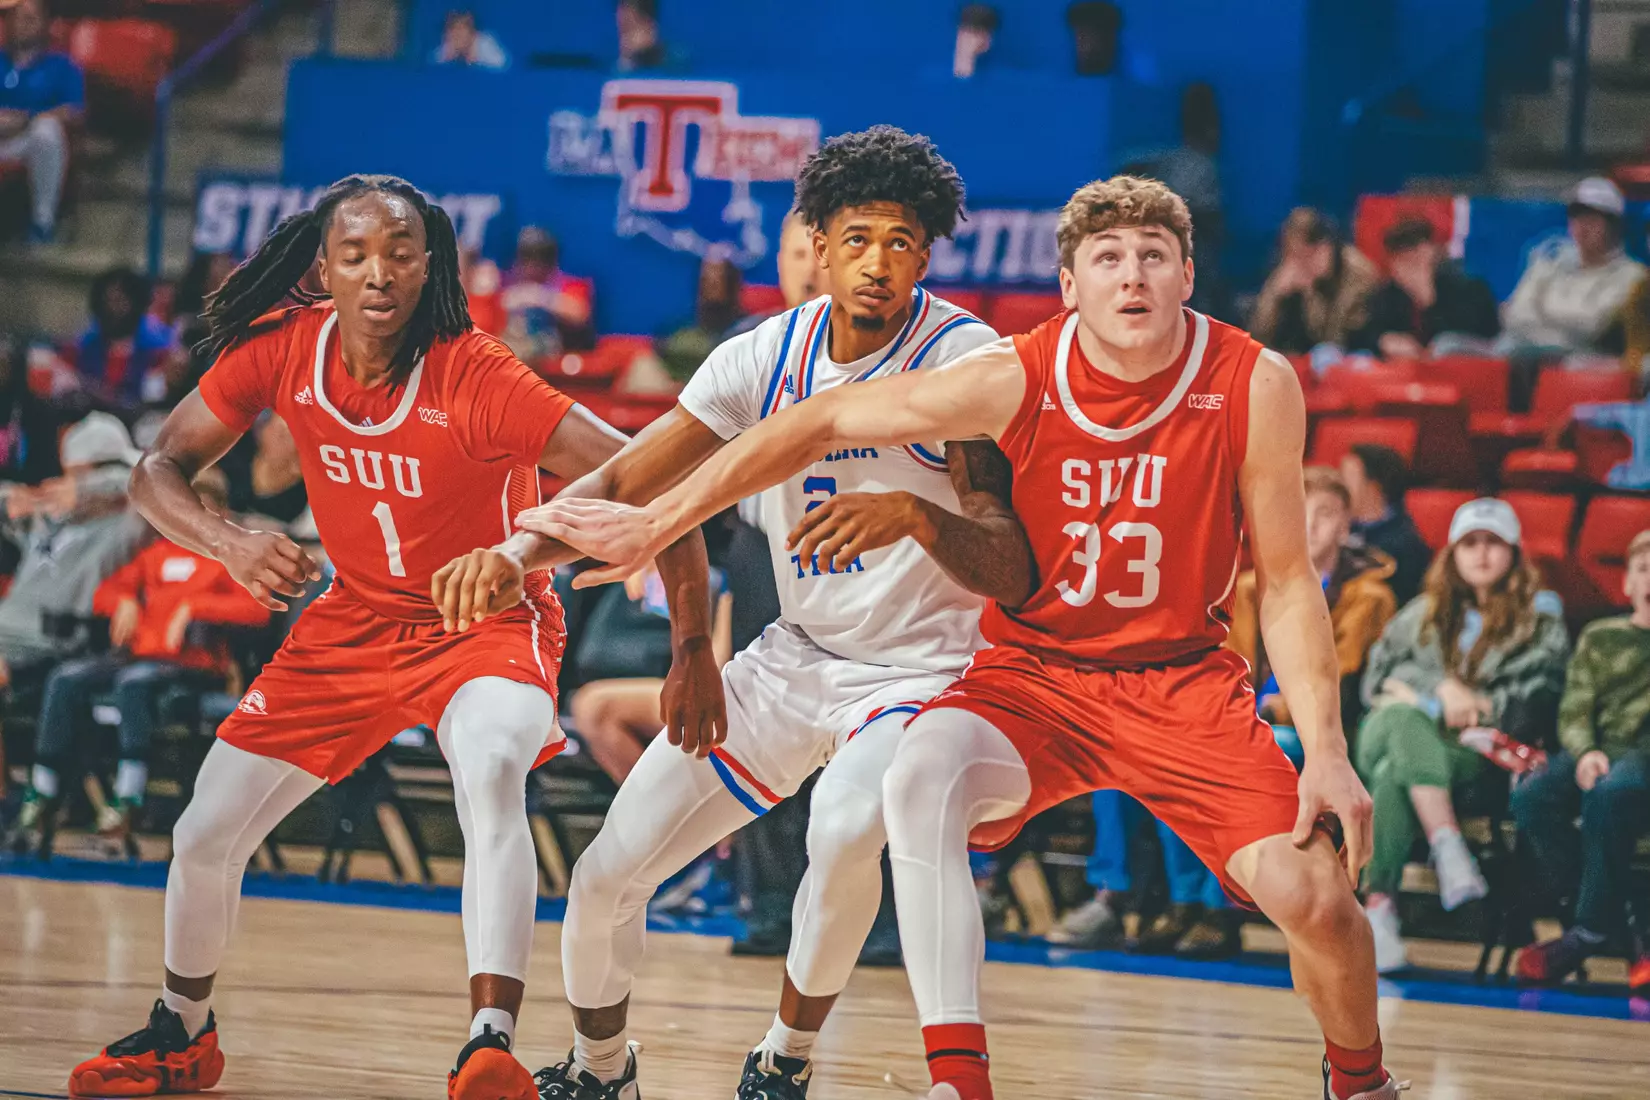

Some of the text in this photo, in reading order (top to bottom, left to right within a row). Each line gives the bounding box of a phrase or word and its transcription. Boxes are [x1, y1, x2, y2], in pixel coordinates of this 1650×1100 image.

[1188, 393, 1224, 410] WAC
[319, 444, 423, 498] SUU
[1061, 453, 1167, 509] SUU
[371, 501, 407, 577] 1
[1054, 521, 1163, 608] 33
